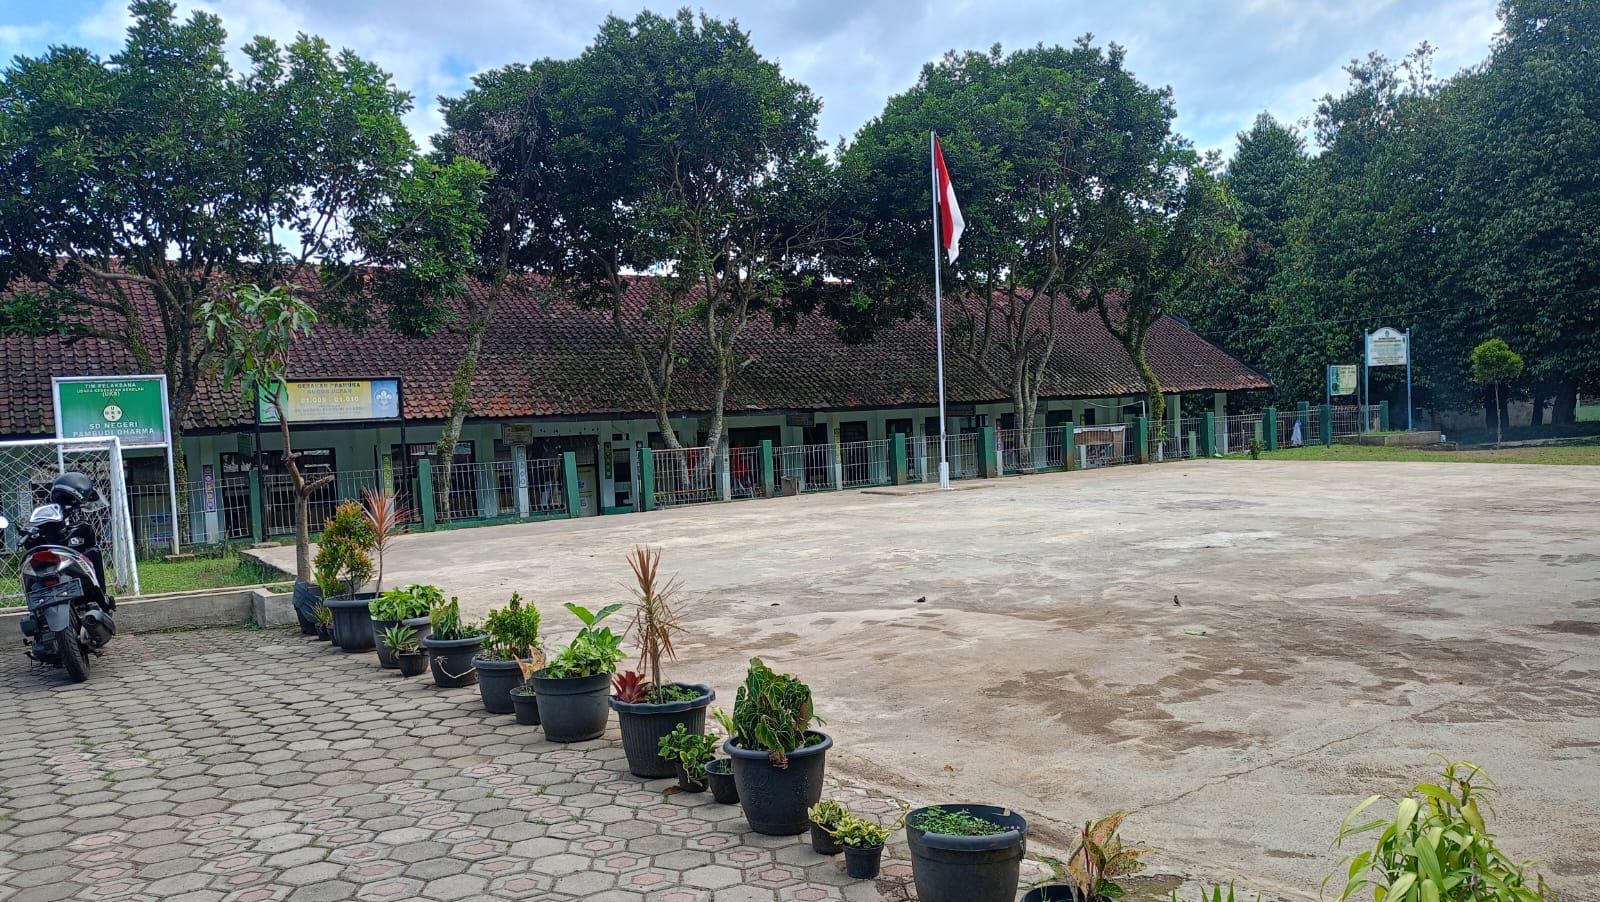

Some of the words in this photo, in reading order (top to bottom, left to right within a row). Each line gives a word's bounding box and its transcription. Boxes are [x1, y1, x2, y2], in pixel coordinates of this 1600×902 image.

[104, 421, 138, 429] NEGERI
[73, 429, 115, 437] PAMBUDI
[117, 427, 154, 436] DHARMA
